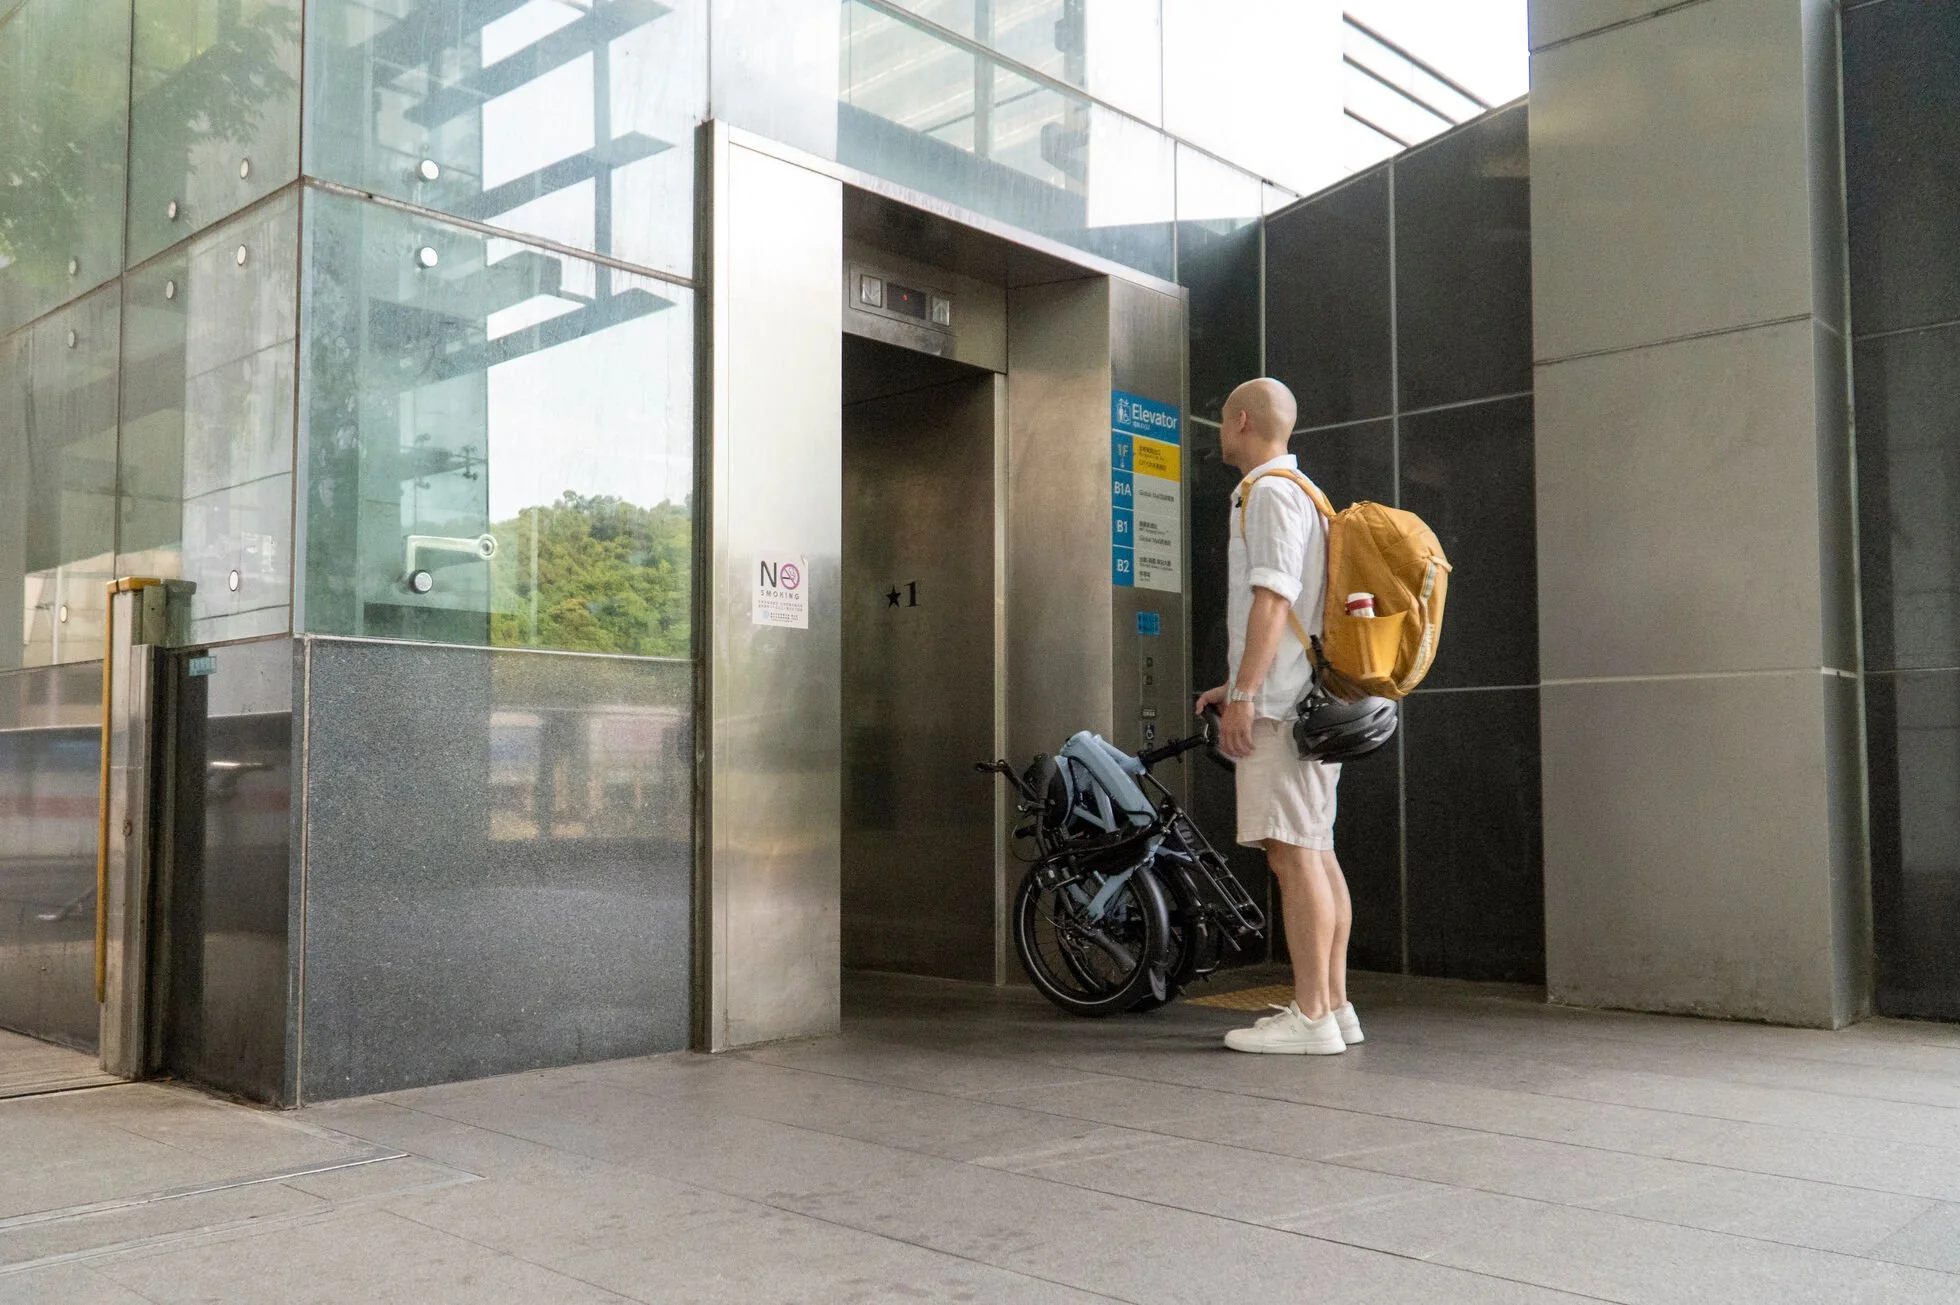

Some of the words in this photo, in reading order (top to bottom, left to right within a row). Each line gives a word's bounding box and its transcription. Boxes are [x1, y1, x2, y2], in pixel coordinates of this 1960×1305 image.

[1131, 403, 1178, 428] Elevator
[1117, 443, 1129, 457] 1F
[1113, 481, 1132, 496] B1A
[1116, 520, 1128, 533] B1
[1116, 559, 1130, 573] B2
[760, 589, 800, 600] SMOKING
